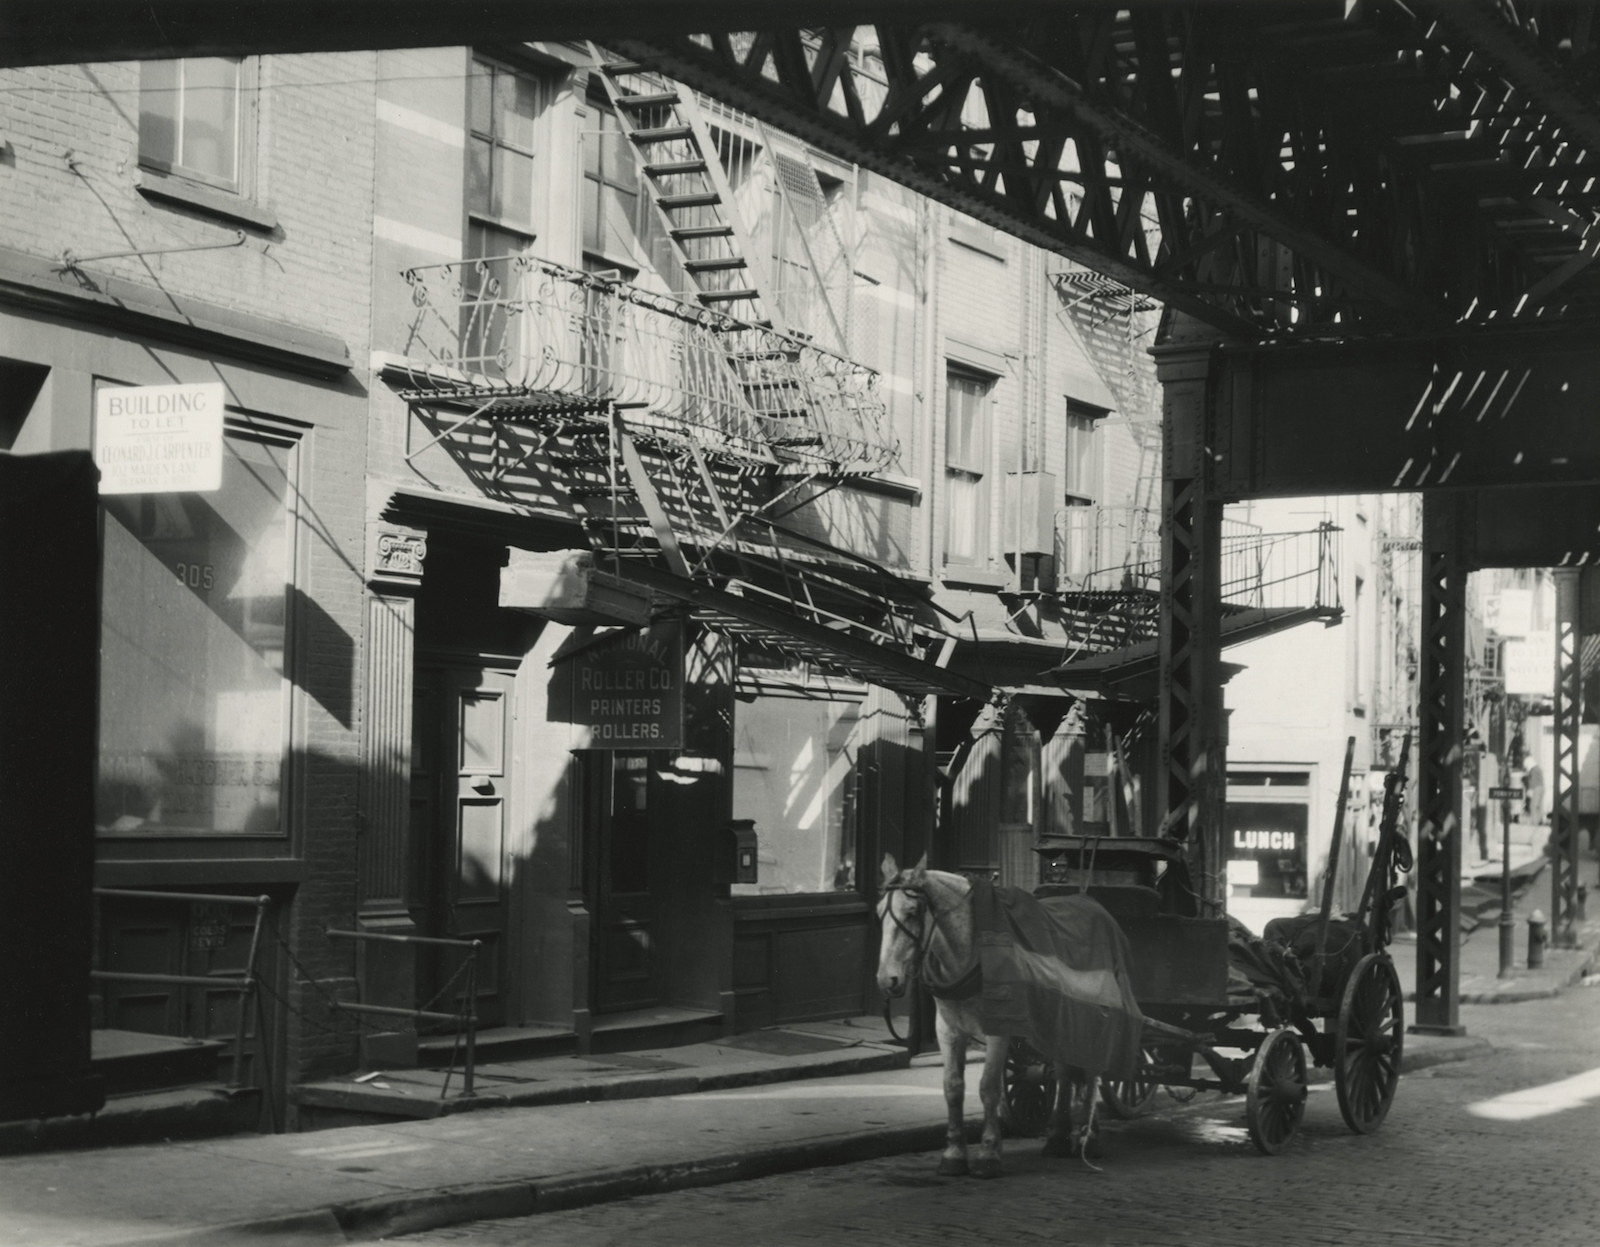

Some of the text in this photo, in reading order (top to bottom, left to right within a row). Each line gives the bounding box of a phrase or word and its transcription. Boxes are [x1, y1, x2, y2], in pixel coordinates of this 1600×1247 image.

[109, 392, 206, 416] BUILDING
[131, 415, 187, 429] TO LET
[102, 445, 146, 464] LEONARD
[155, 441, 212, 460] CARPENTER
[130, 463, 169, 476] MAIDEN
[172, 460, 198, 474] LANE
[177, 562, 214, 589] 305
[581, 667, 674, 690] ROLLER CO.
[590, 698, 661, 715] PRINTERS
[591, 722, 665, 739] ROLLERS.
[1234, 830, 1295, 850] LUNCH
[193, 924, 227, 936] COLDS
[192, 936, 226, 947] FEVER
